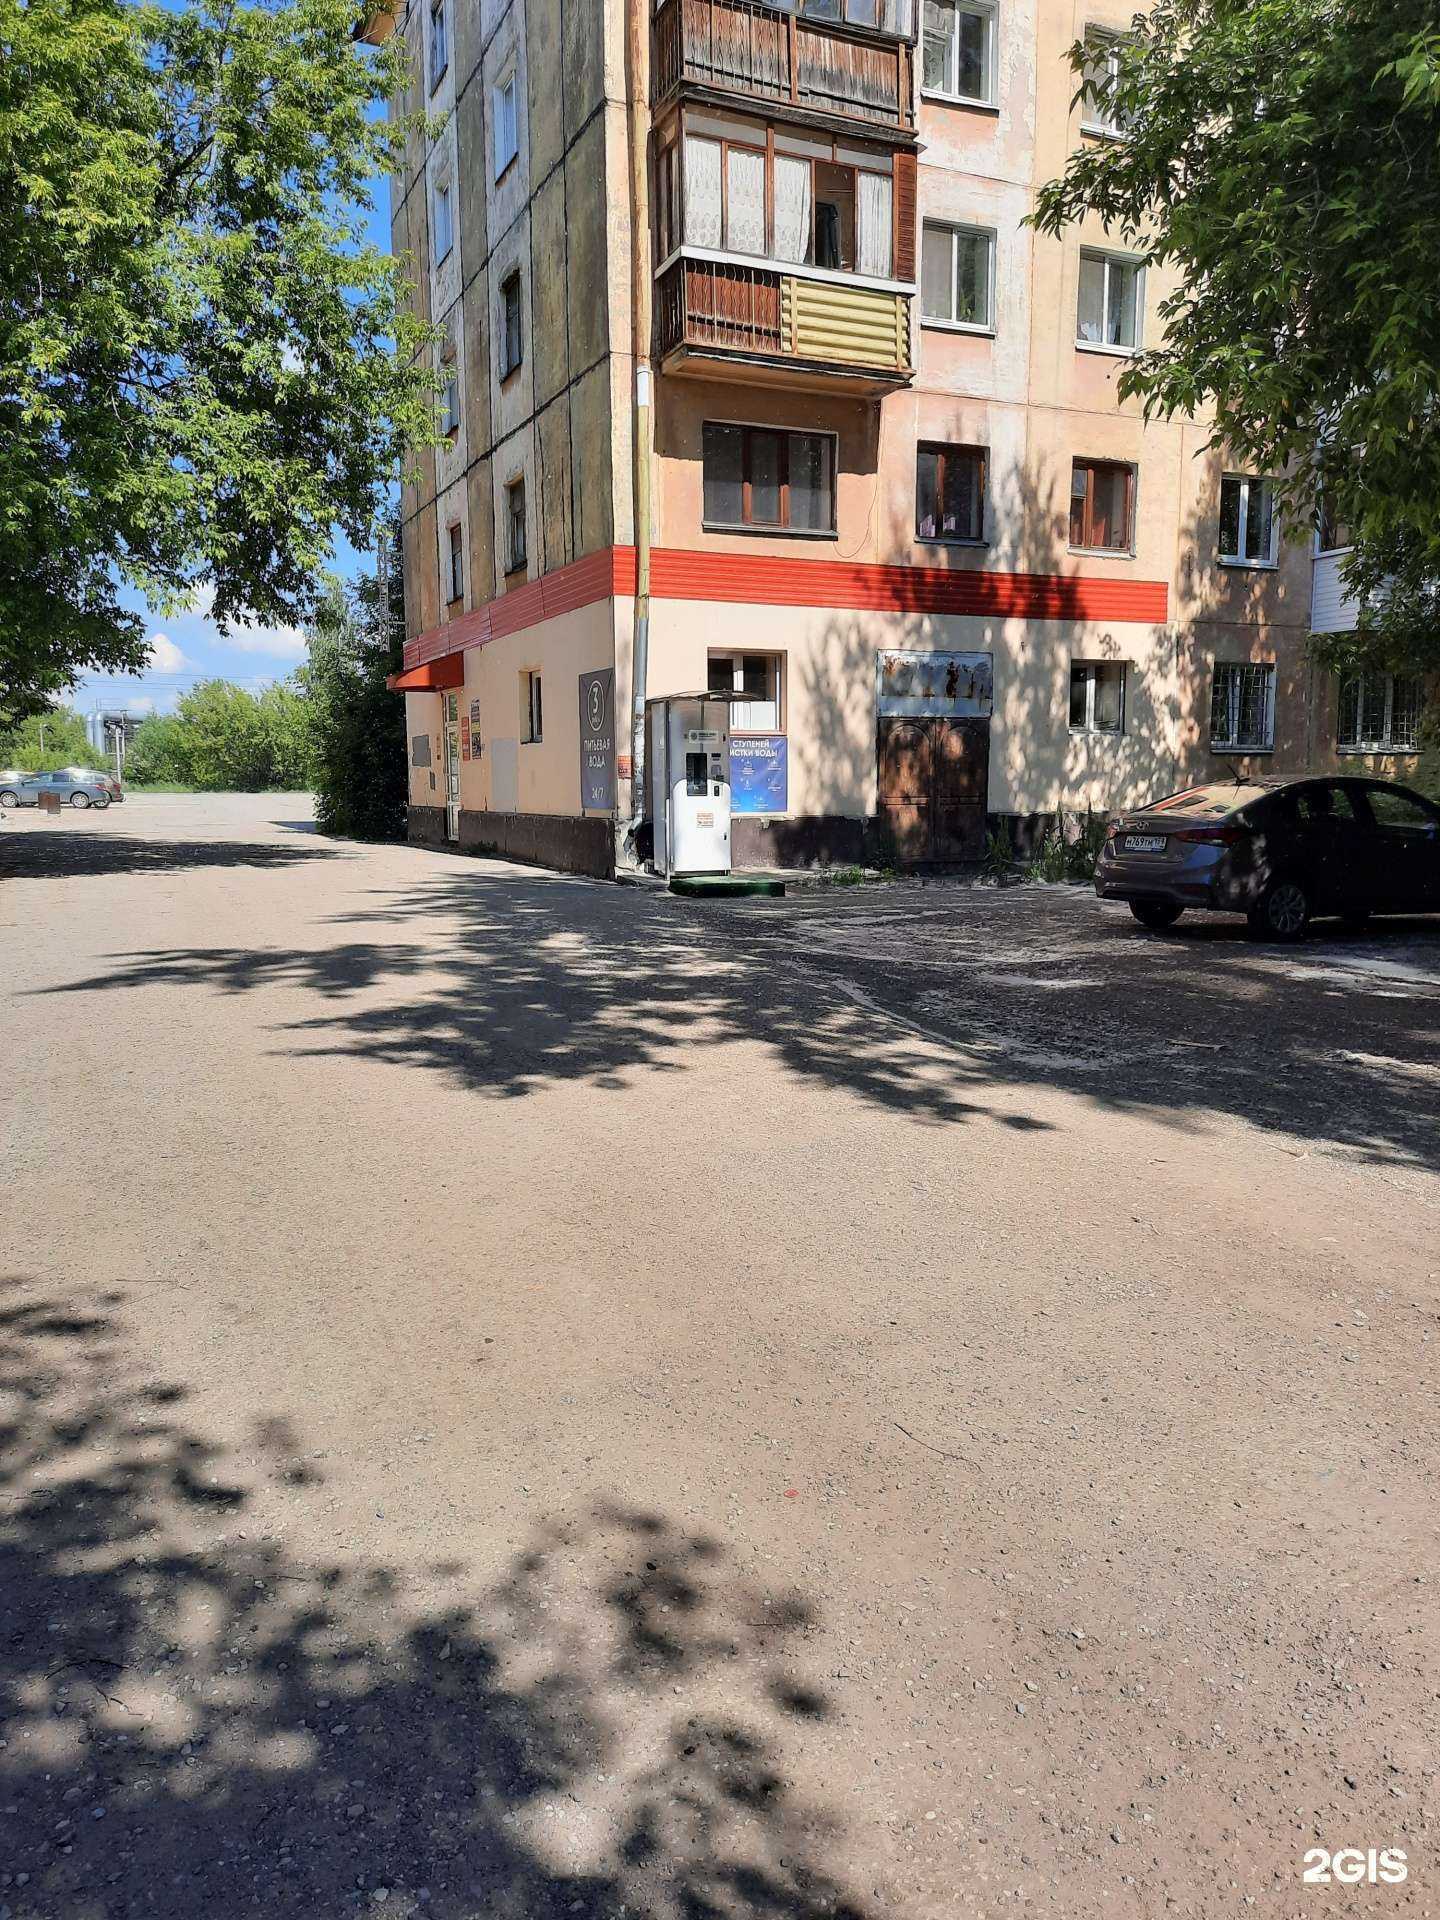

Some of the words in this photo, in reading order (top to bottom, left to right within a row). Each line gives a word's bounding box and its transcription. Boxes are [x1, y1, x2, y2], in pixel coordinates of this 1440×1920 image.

[583, 738, 610, 752] ПИТЬЕВАЯ
[732, 739, 769, 748] СТУПЕНЕЙ
[755, 749, 778, 758] ВОДЫ
[588, 755, 606, 769] ВОДА
[591, 787, 604, 801] 24/7
